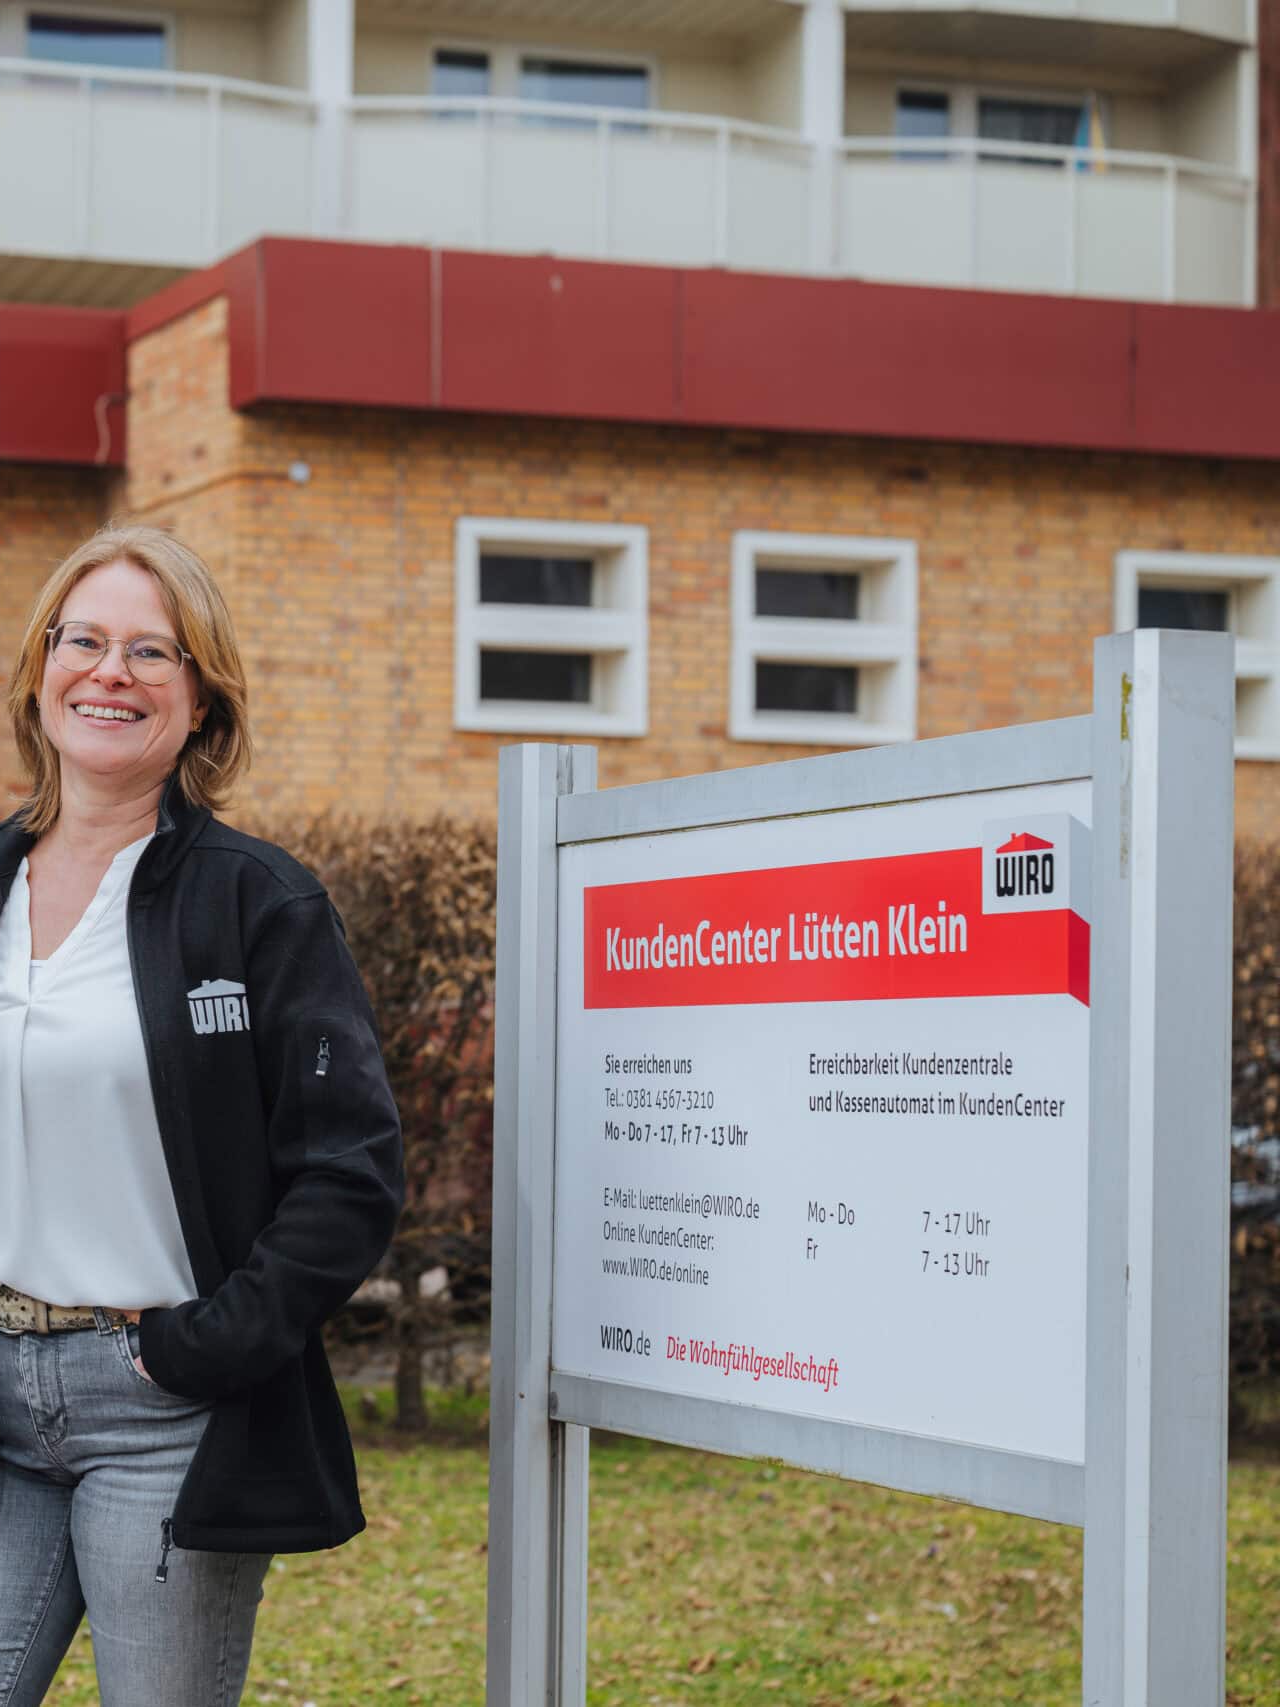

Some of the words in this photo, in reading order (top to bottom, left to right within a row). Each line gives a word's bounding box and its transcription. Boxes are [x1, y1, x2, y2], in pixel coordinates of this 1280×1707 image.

[995, 853, 1054, 897] WIRO
[605, 920, 782, 971] KundenCenter
[788, 912, 880, 961] Lütten
[888, 901, 968, 956] Klein
[605, 1054, 621, 1074] Sie
[622, 1054, 671, 1074] erreichen
[673, 1057, 693, 1074] uns
[809, 1052, 899, 1076] Erreichbarkeit
[903, 1052, 1014, 1076] Kundenzentrale
[604, 1087, 624, 1107] Tel.:
[626, 1088, 652, 1108] 0381
[656, 1089, 714, 1111] 4567-3210
[809, 1091, 832, 1112] und
[836, 1090, 935, 1115] Kassenautomat
[938, 1092, 956, 1115] im
[960, 1092, 1066, 1118] KundenCenter
[604, 1121, 620, 1141] Mo
[628, 1122, 642, 1142] Do
[645, 1124, 651, 1142] 7
[661, 1125, 677, 1146] 17,
[682, 1123, 692, 1144] Fr
[695, 1126, 702, 1145] 7
[711, 1126, 725, 1146] 13
[728, 1124, 749, 1146] Uhr
[604, 1187, 637, 1209] E-Mail:
[639, 1189, 760, 1219] luettenklein@WIRO.de
[807, 1200, 826, 1223] Mo
[838, 1202, 855, 1226] Do
[603, 1220, 636, 1243] Online
[638, 1223, 715, 1251] KundenCenter:
[922, 1211, 931, 1233] 7
[944, 1213, 961, 1236] 17
[966, 1211, 991, 1237] Uhr
[806, 1237, 818, 1260] Fr
[602, 1256, 709, 1286] www.WIRO.de/online
[921, 1250, 930, 1273] 7
[943, 1253, 960, 1276] 13
[965, 1251, 990, 1277] Uhr
[600, 1324, 651, 1356] WIRO.de
[666, 1336, 686, 1361] Die
[689, 1339, 839, 1392] Wohnfühlgesellschaft
